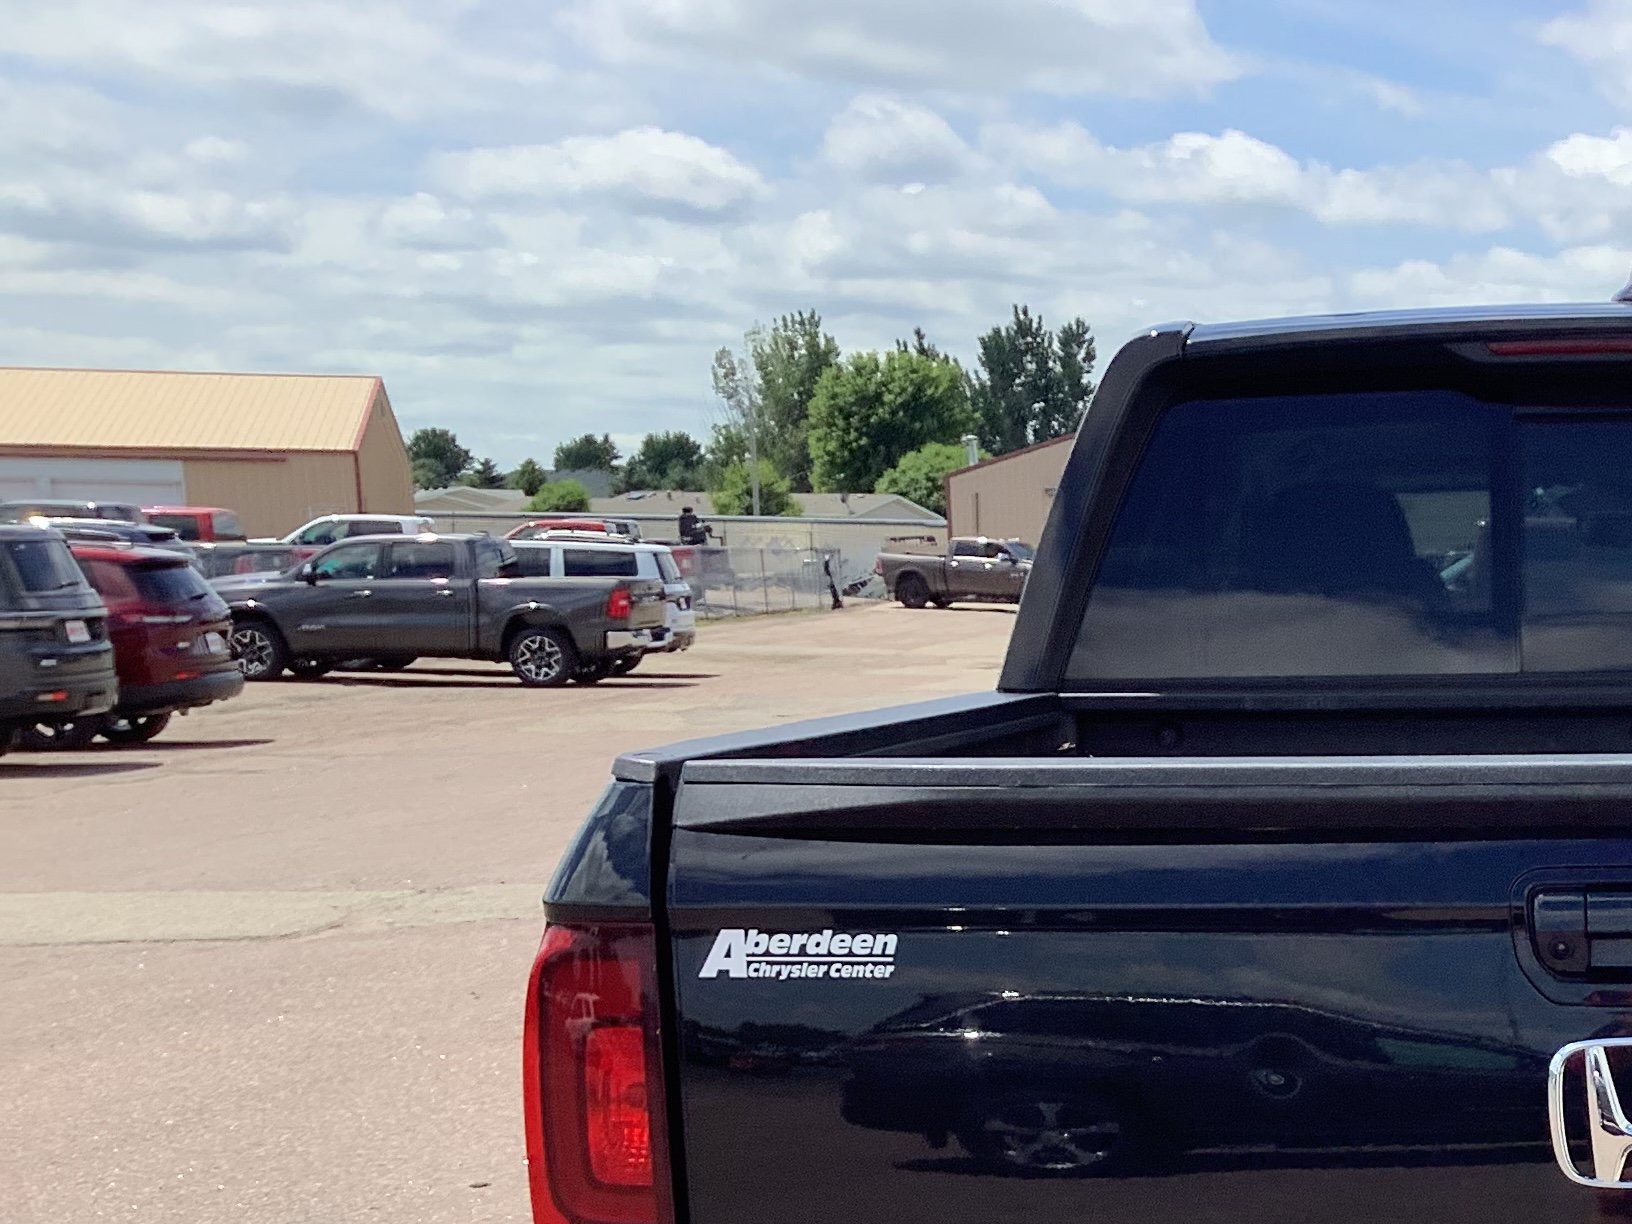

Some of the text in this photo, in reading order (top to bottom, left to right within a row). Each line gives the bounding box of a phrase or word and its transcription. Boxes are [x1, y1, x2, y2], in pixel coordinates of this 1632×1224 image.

[698, 928, 898, 978] Aberdeen
[748, 961, 895, 980] Chrysler Center
